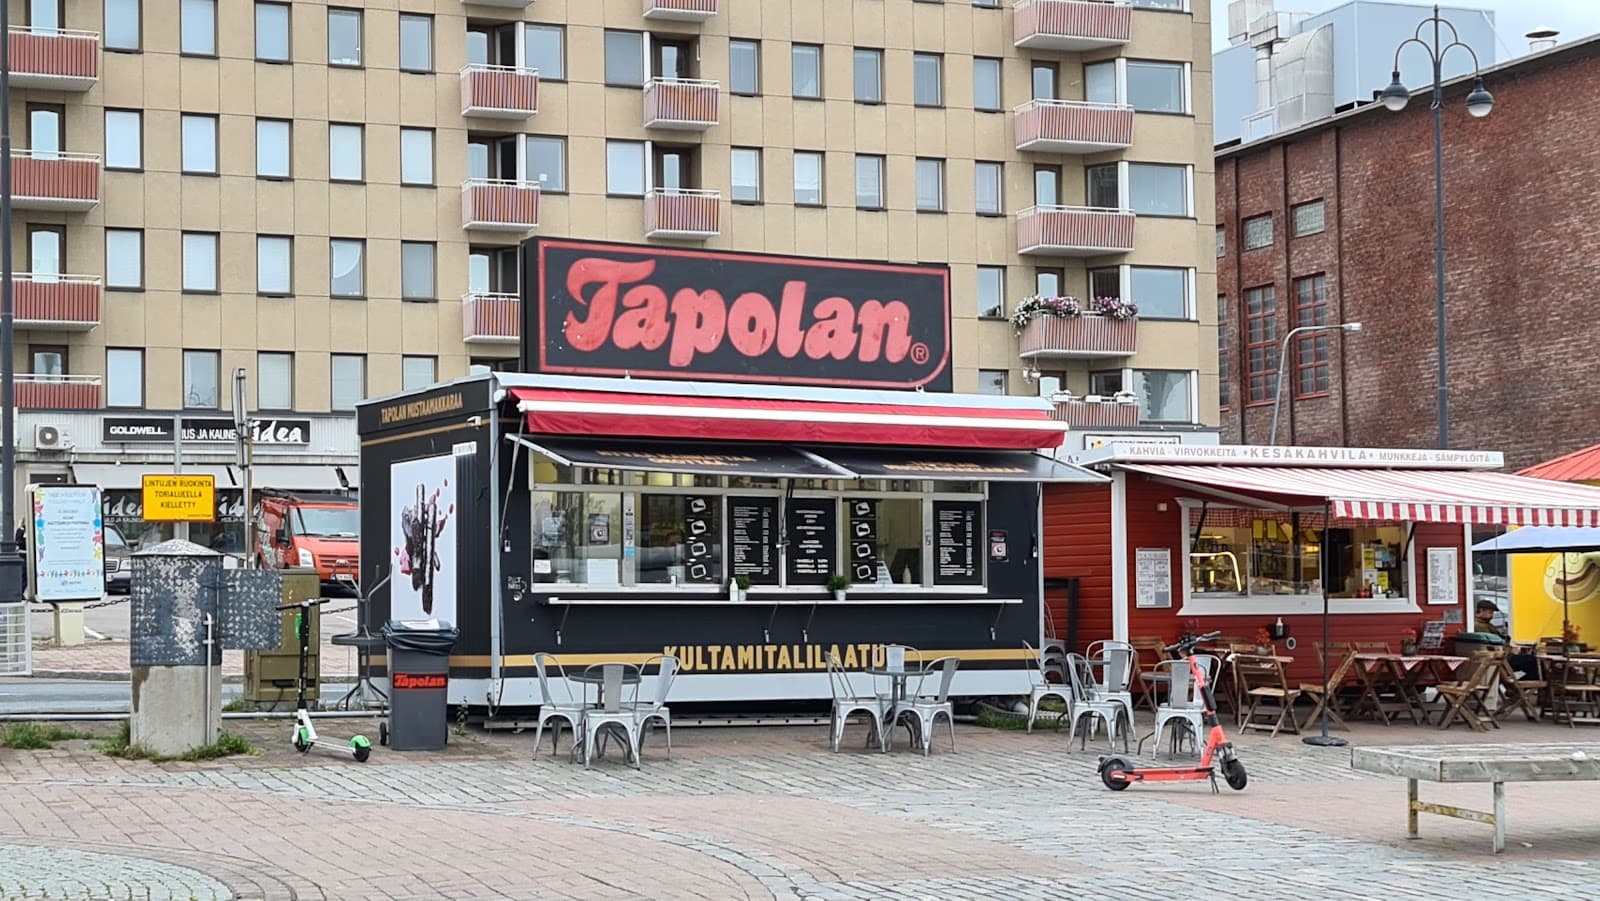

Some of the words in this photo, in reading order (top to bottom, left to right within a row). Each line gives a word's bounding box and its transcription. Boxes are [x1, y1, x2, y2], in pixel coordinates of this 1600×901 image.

[565, 258, 912, 367] Tapolan
[381, 404, 407, 424] TAPOLAN
[109, 425, 168, 436] GOLDWELL
[181, 428, 196, 440] IUS
[196, 428, 208, 440] JA
[208, 429, 237, 440] KAUNE
[1129, 446, 1166, 456] KAHVIA
[1174, 447, 1237, 458] VIRVOKKEITA
[1378, 452, 1429, 462] MUNKKEJA
[663, 644, 896, 671] KULTAMITALILAATU
[394, 674, 446, 688] Tapolan
